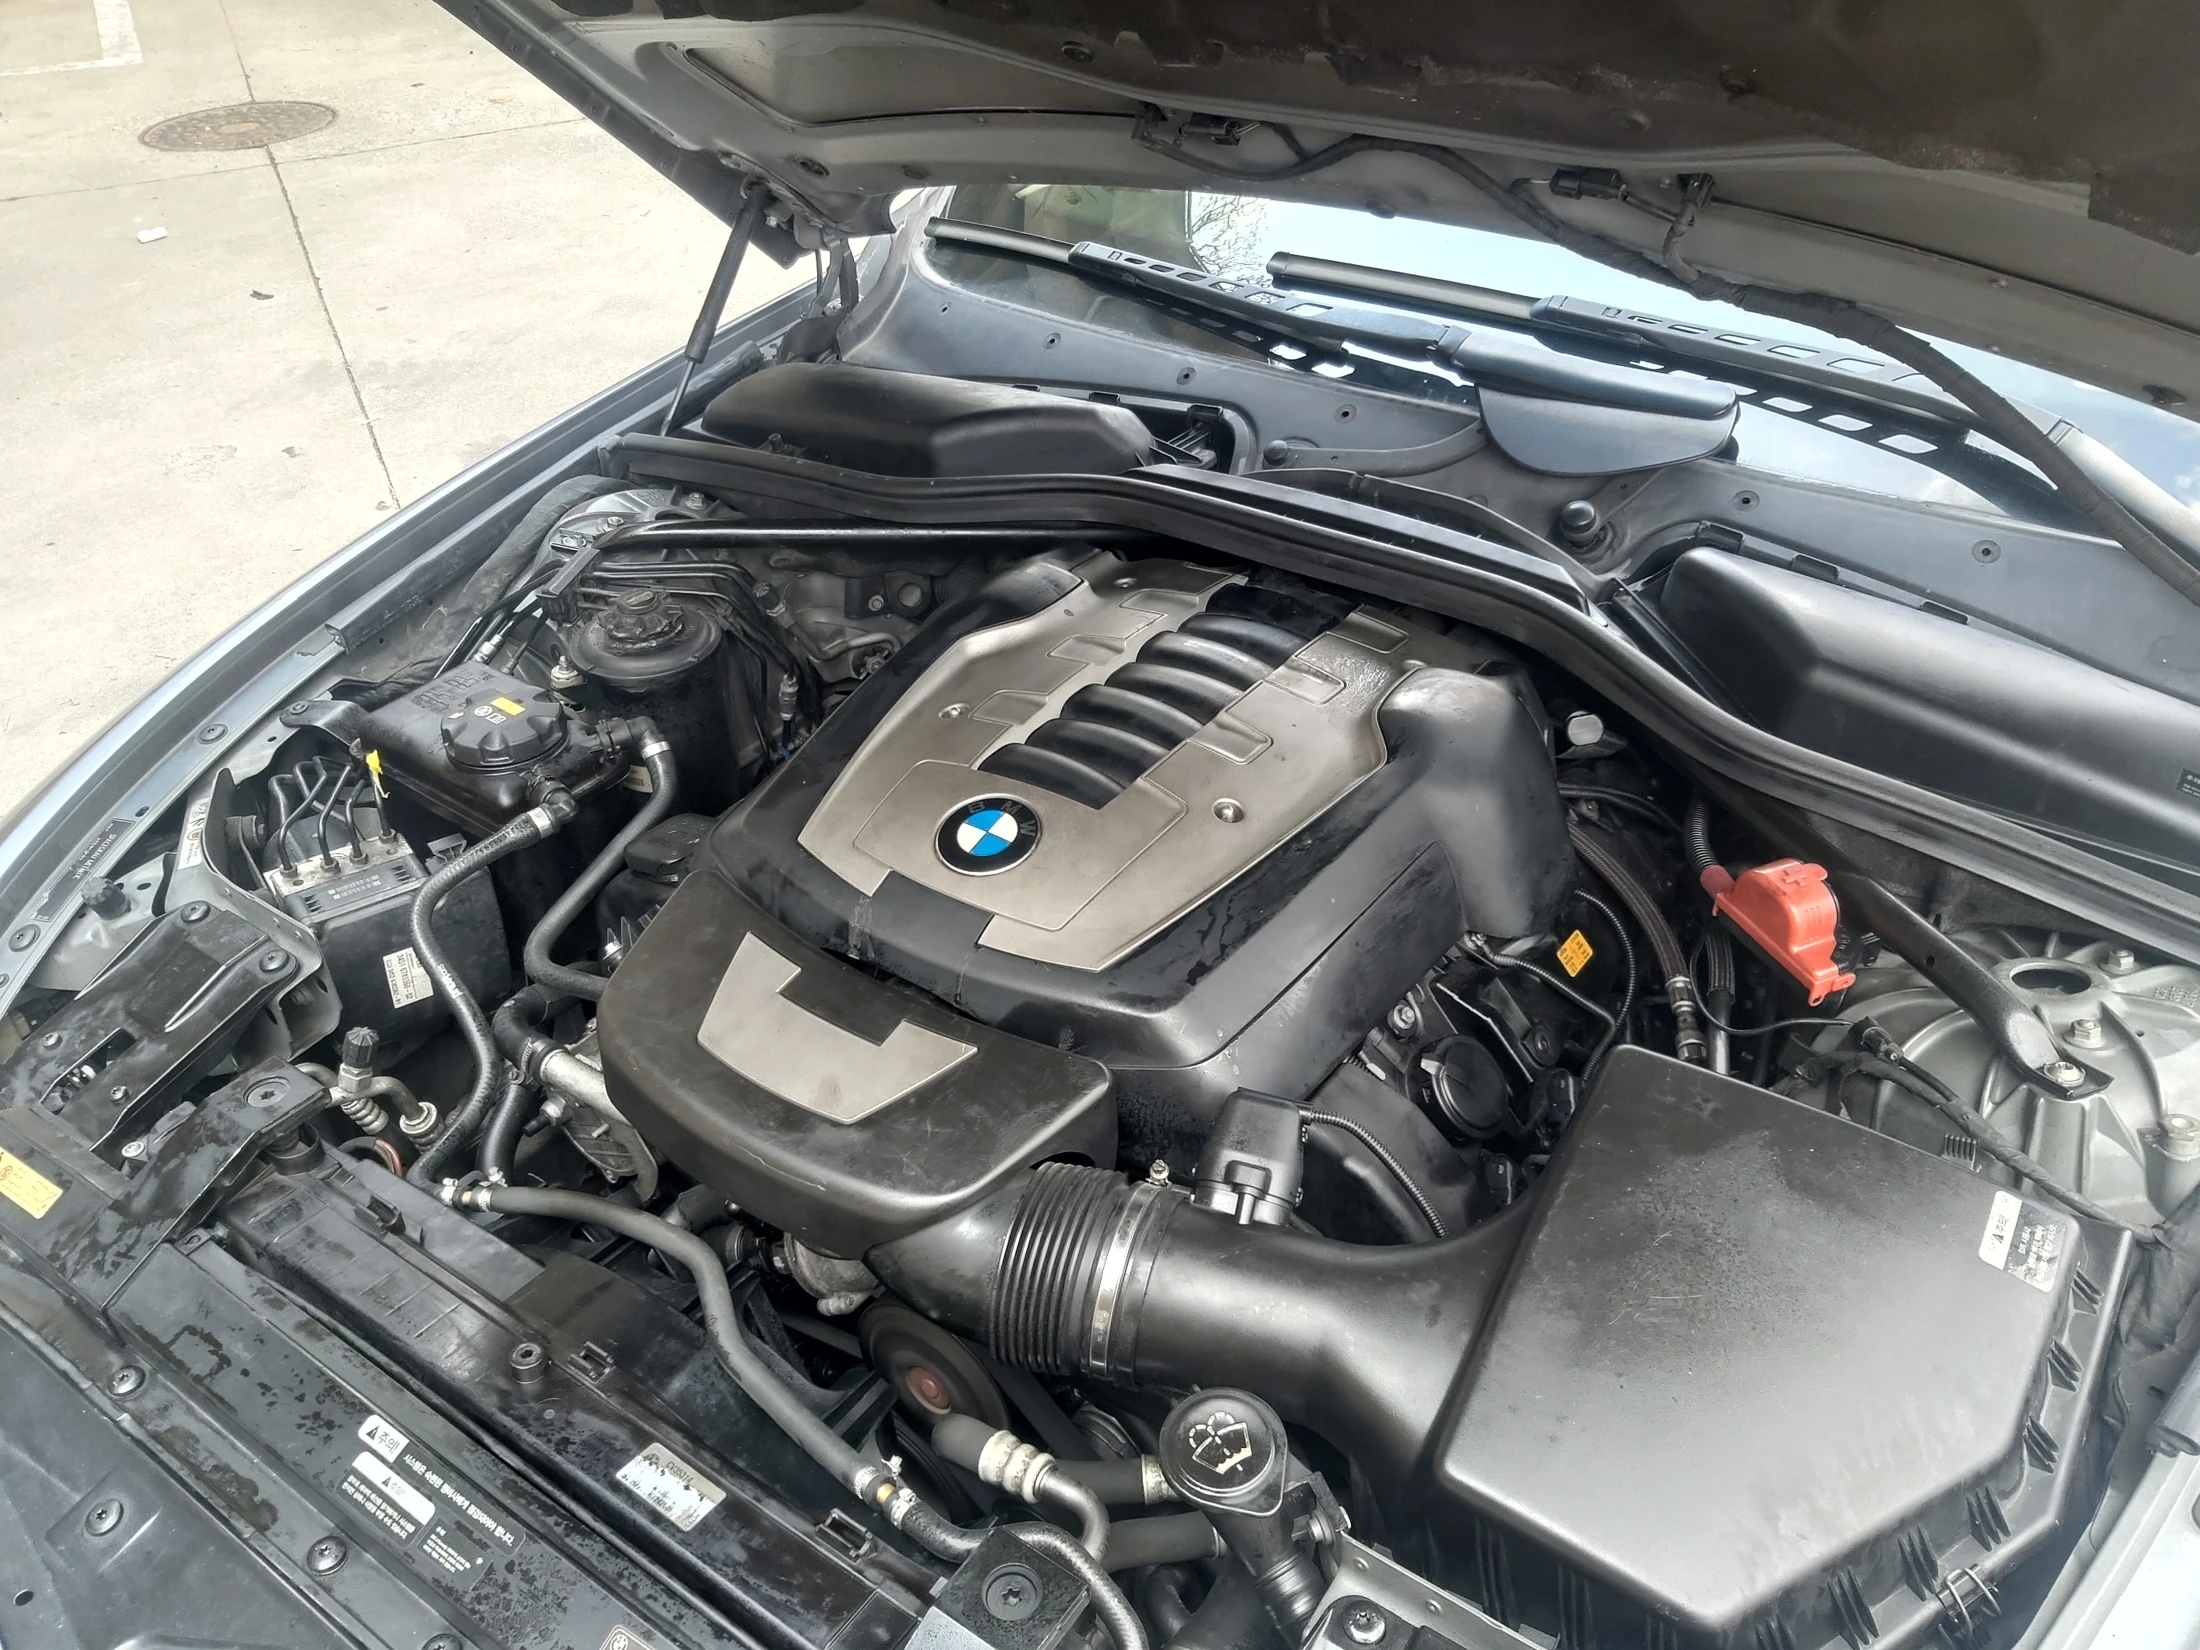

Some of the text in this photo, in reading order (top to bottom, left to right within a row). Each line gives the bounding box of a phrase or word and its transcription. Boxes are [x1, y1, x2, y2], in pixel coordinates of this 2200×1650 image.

[967, 800, 1037, 837] BMW
[378, 1431, 400, 1453] 주의!
[402, 1453, 426, 1475] 시스템은
